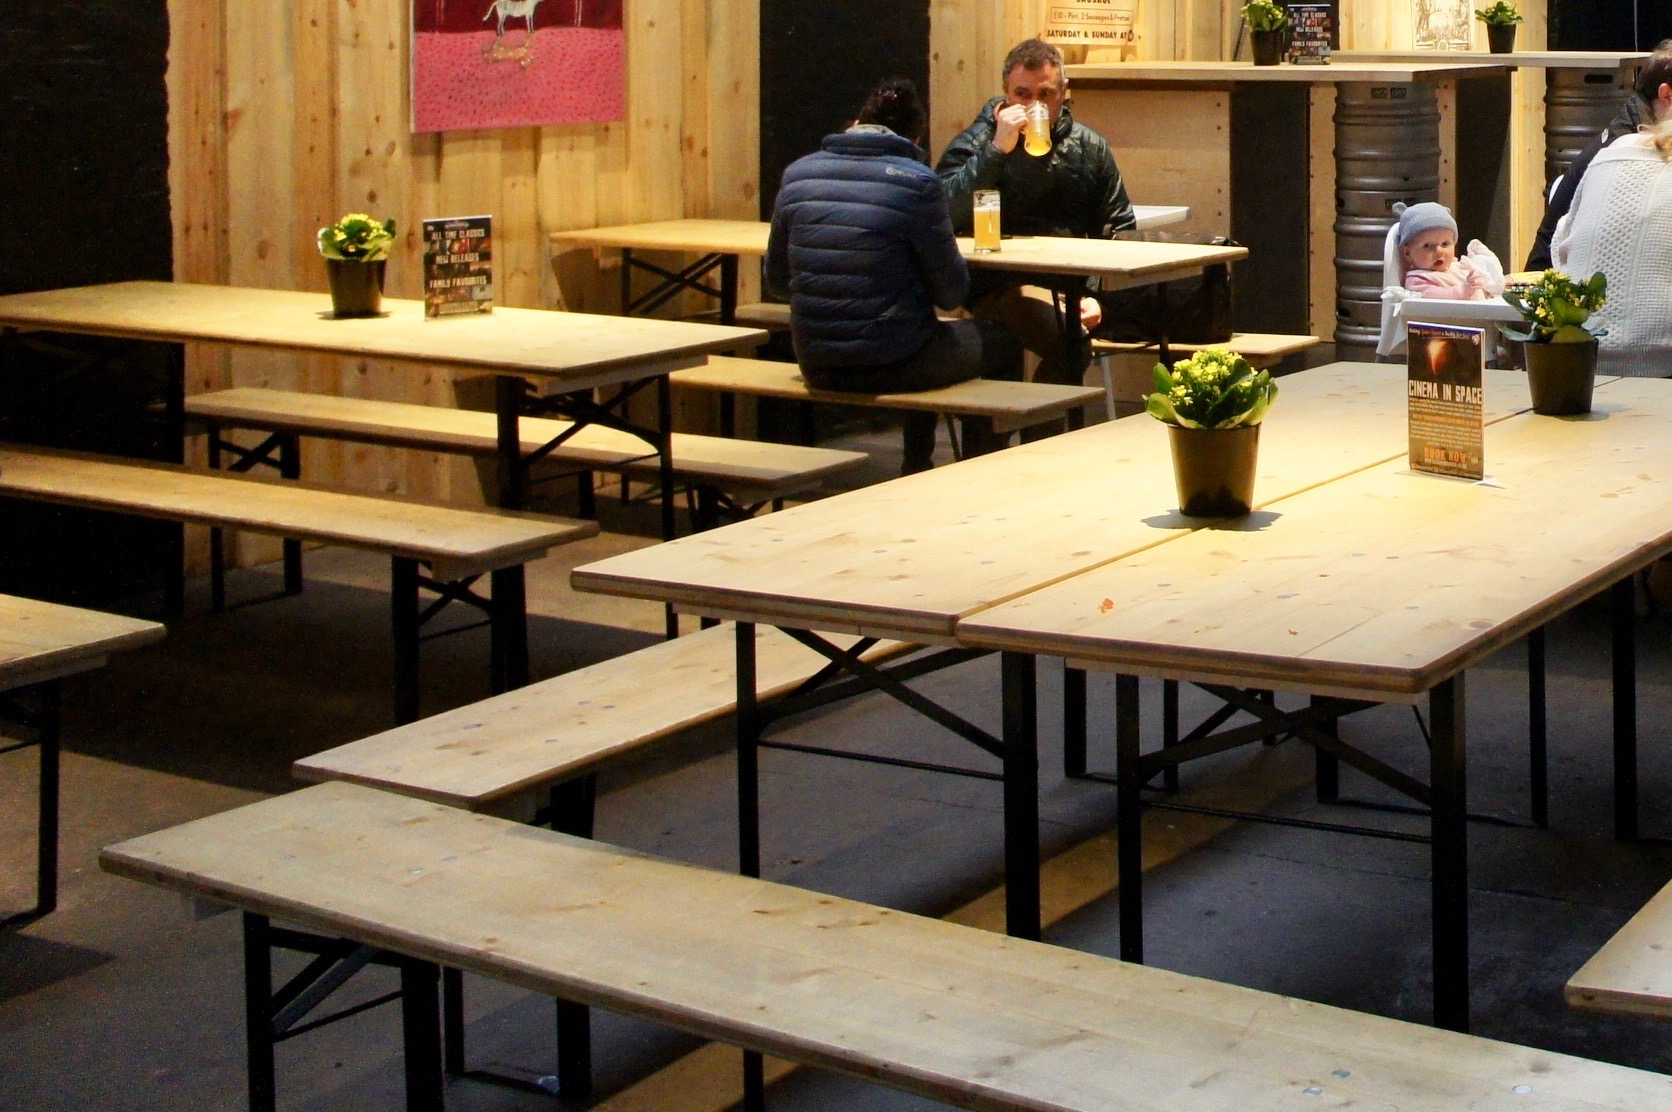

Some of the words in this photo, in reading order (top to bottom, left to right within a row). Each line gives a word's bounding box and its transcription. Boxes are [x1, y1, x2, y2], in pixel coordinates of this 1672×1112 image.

[1086, 14, 1109, 22] Sausages
[1047, 30, 1080, 38] SATURDAY
[1092, 31, 1117, 39] SUNDAY
[432, 232, 442, 240] ALL
[436, 255, 448, 264] NEW
[451, 252, 479, 263] RELEASES
[430, 279, 450, 288] FAMILY
[1409, 380, 1438, 399] CINEMA
[1443, 383, 1451, 401] IN
[1455, 385, 1482, 404] SPACE
[1424, 447, 1445, 460] BOOK
[1449, 451, 1466, 463] NOW
